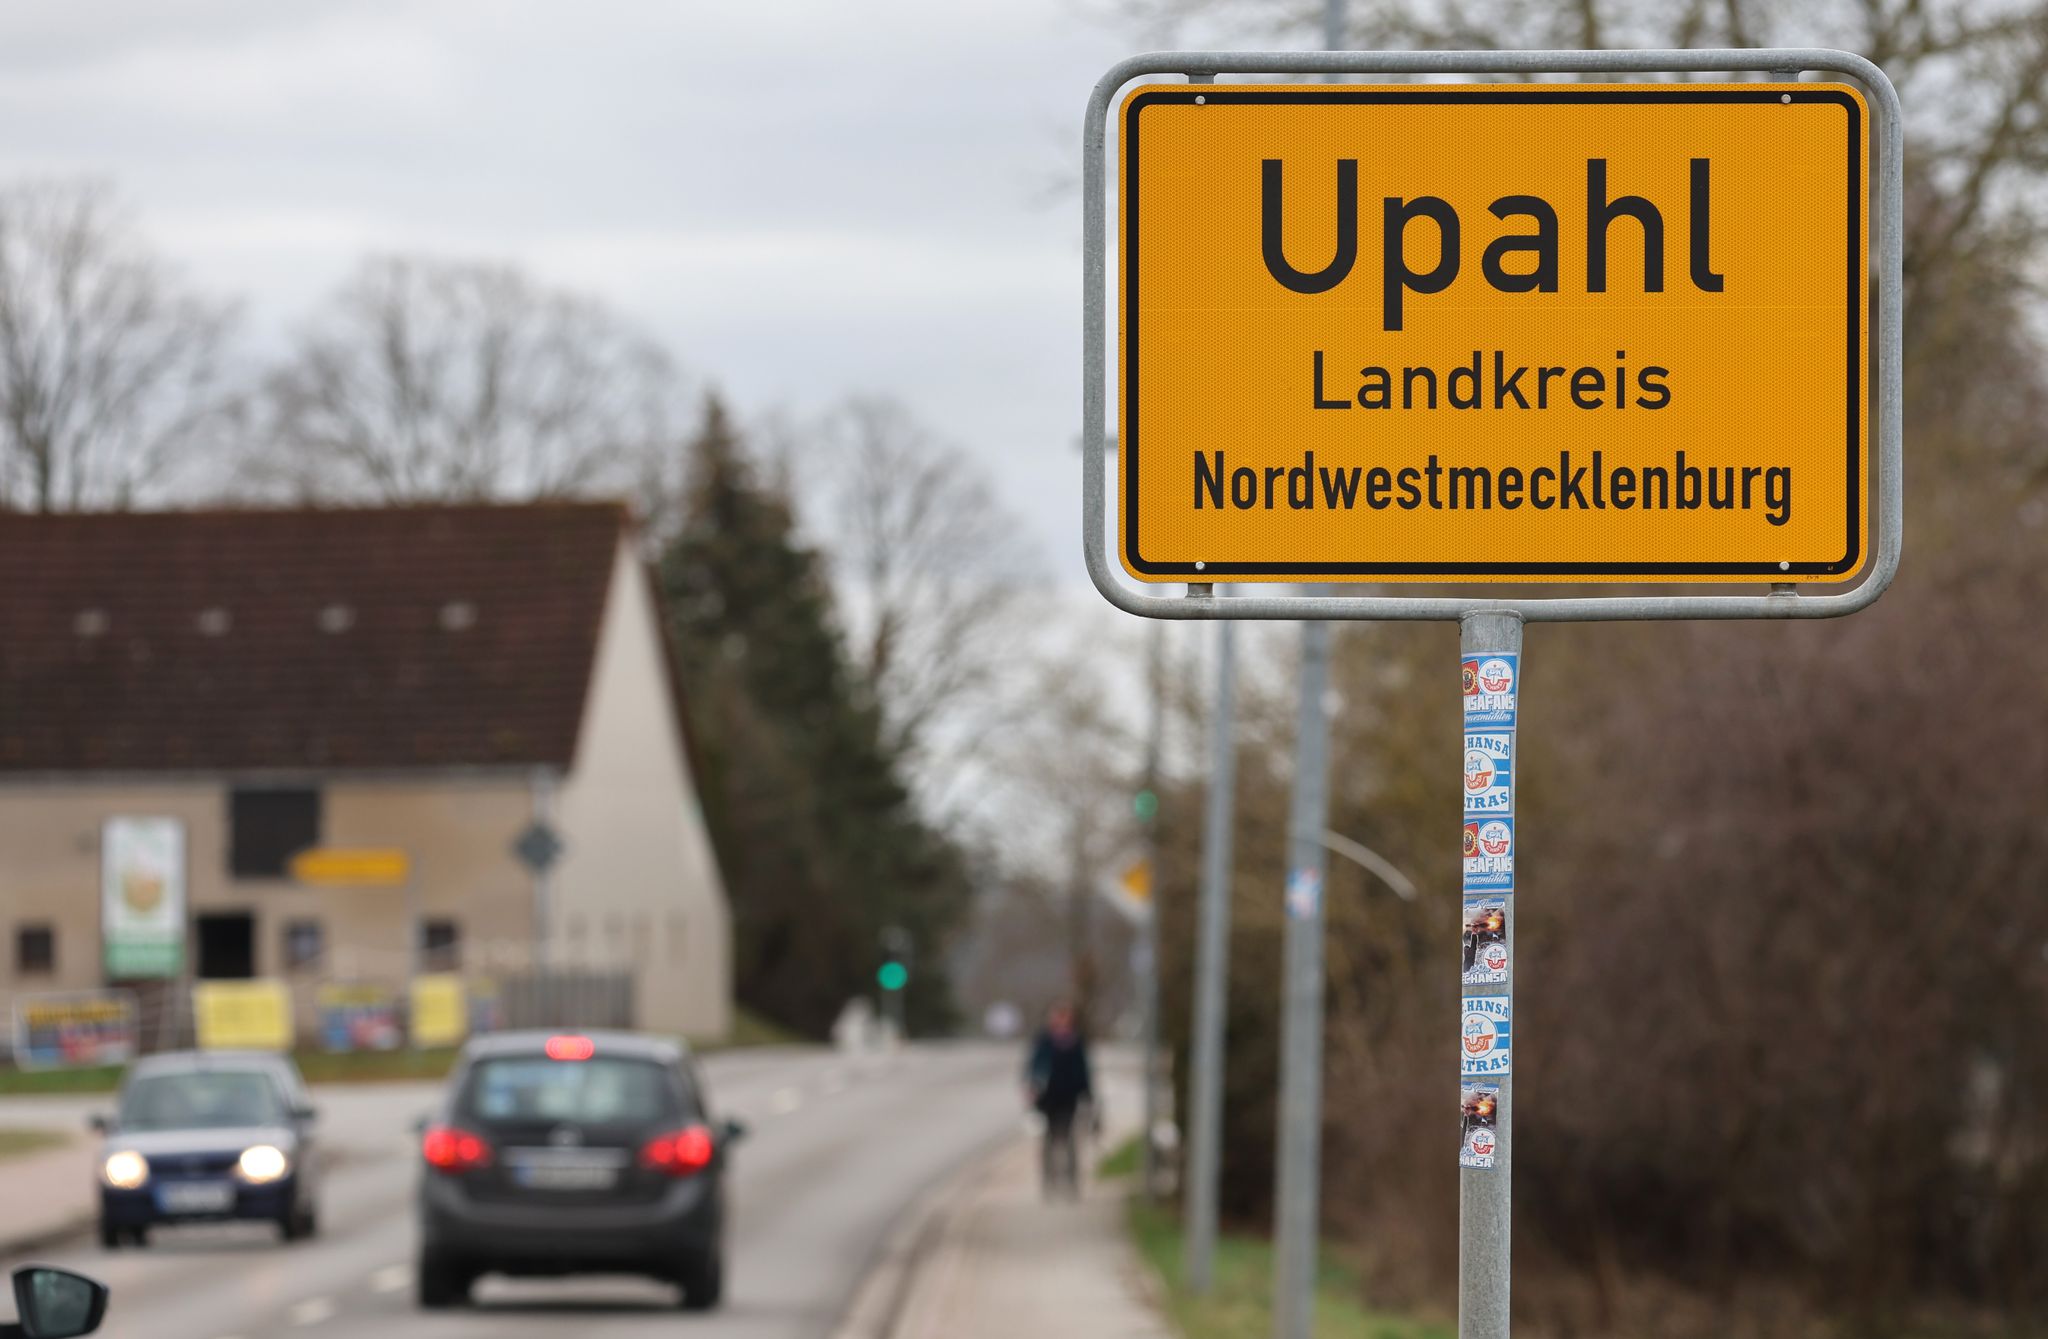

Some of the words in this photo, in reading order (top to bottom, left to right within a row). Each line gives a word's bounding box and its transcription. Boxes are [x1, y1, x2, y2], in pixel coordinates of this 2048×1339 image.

[1261, 157, 1724, 331] Upahl
[1313, 350, 1672, 411] Landkreis
[1193, 450, 1793, 526] Nordwestmecklenburg
